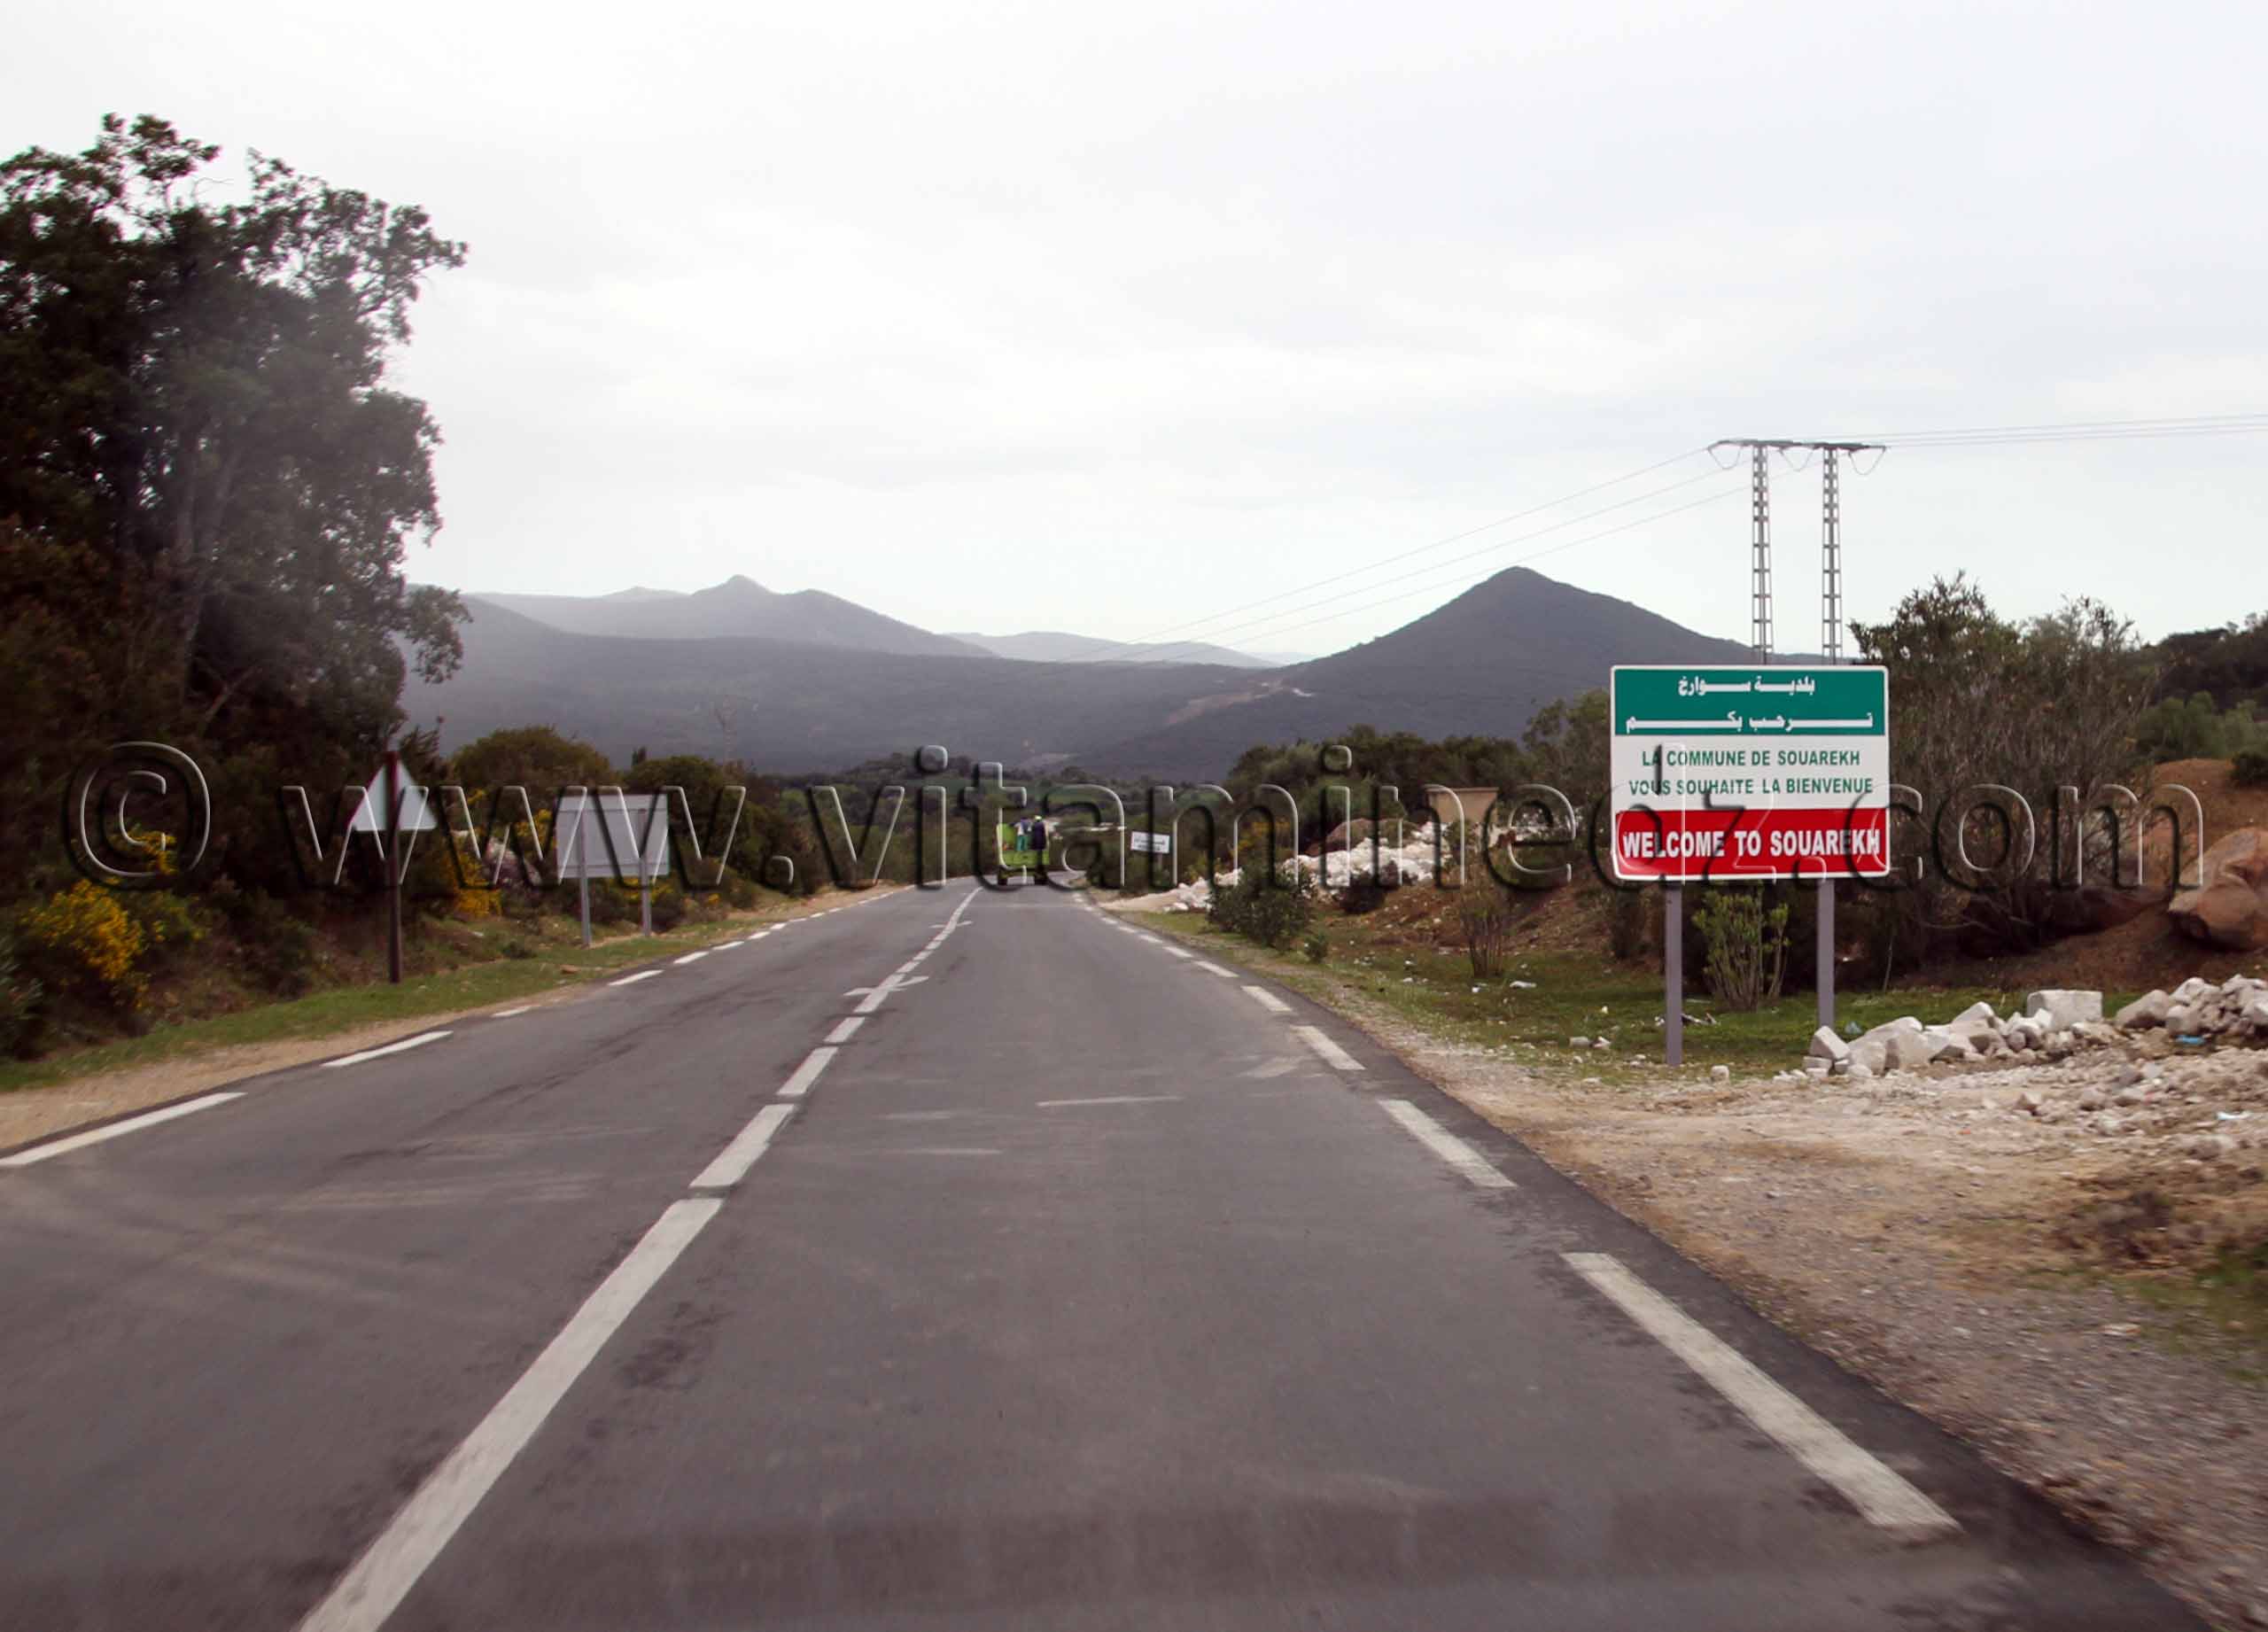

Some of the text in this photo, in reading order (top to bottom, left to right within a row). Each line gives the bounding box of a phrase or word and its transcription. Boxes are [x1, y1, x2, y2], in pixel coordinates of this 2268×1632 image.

[1642, 750, 1860, 766] LA COMMUNE DE SOUAREKH
[1629, 778, 1873, 796] VOUS SOUHAITE LA BIENVENUE
[1622, 828, 1881, 859] WELCOME TO SOUAREKH
